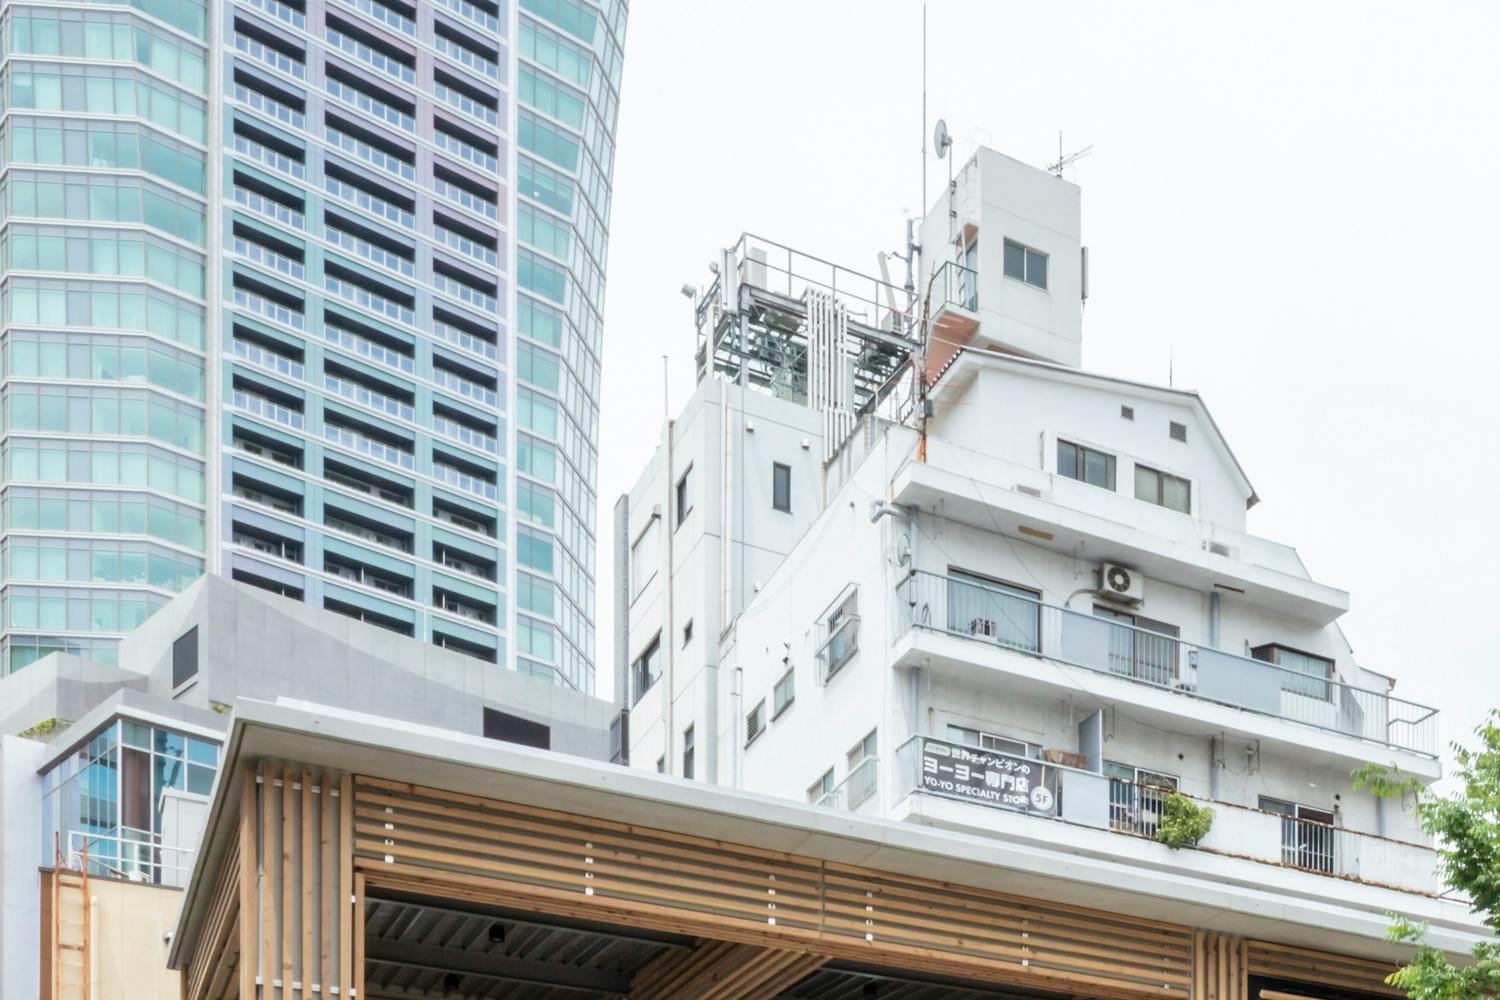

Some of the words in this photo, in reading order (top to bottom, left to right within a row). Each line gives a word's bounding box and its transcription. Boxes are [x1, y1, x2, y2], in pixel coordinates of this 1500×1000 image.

[923, 755, 1029, 793] ヨーヨー専門店
[923, 775, 954, 790] YO-YO
[955, 783, 1001, 801] SPECIALTY
